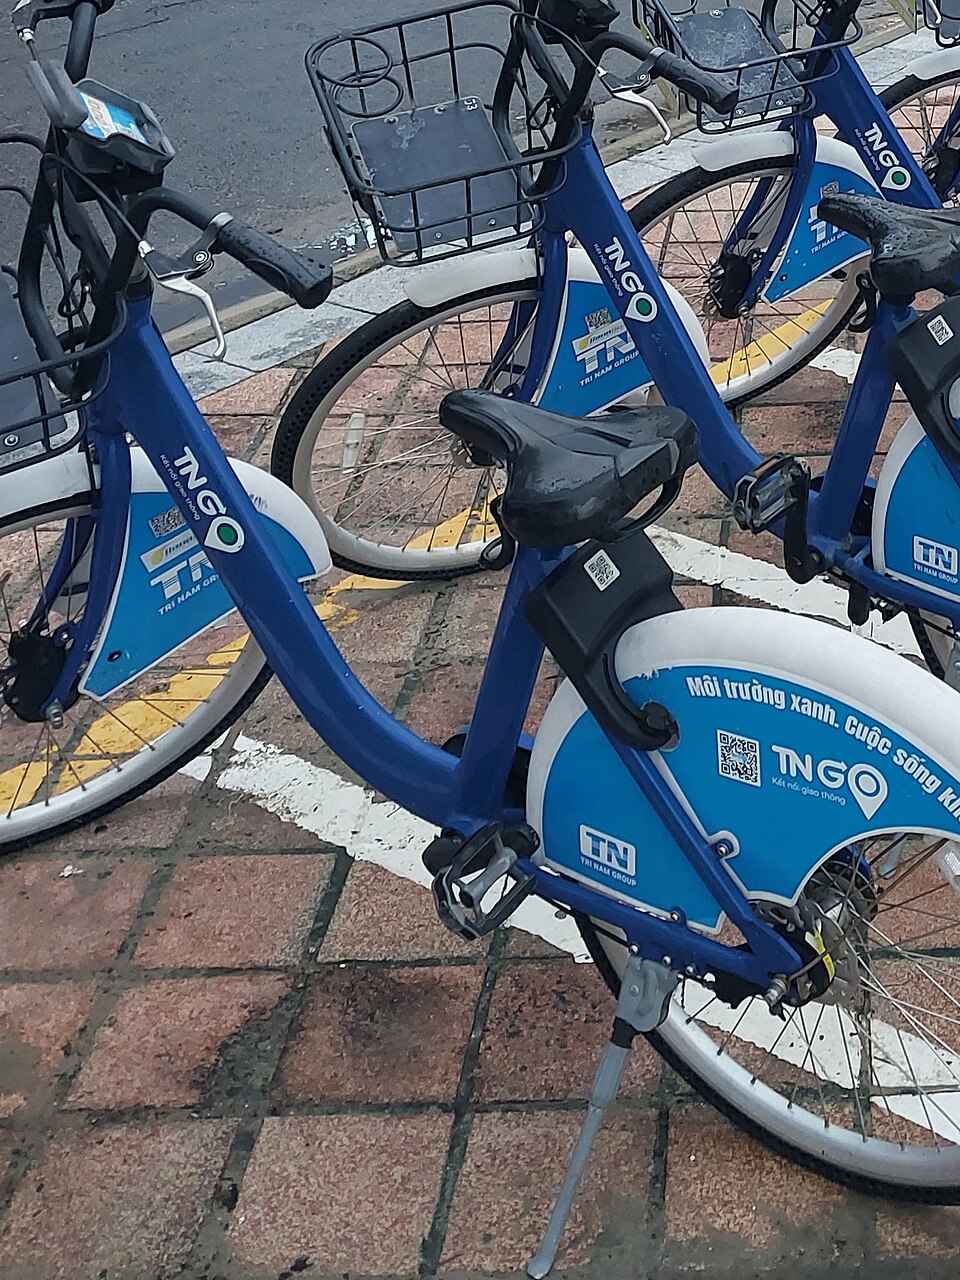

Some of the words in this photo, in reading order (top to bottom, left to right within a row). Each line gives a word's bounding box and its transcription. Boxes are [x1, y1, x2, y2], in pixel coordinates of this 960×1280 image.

[576, 331, 636, 375] TN
[918, 539, 952, 571] TN
[686, 674, 721, 698] Môi
[723, 677, 785, 710] trường
[790, 692, 840, 728] xanh.
[844, 714, 892, 756] Cuộc
[892, 748, 943, 795] sống
[585, 830, 629, 871] TN
[580, 856, 592, 868] TRI
[593, 862, 611, 876] NAM
[611, 871, 637, 887] GROUP
